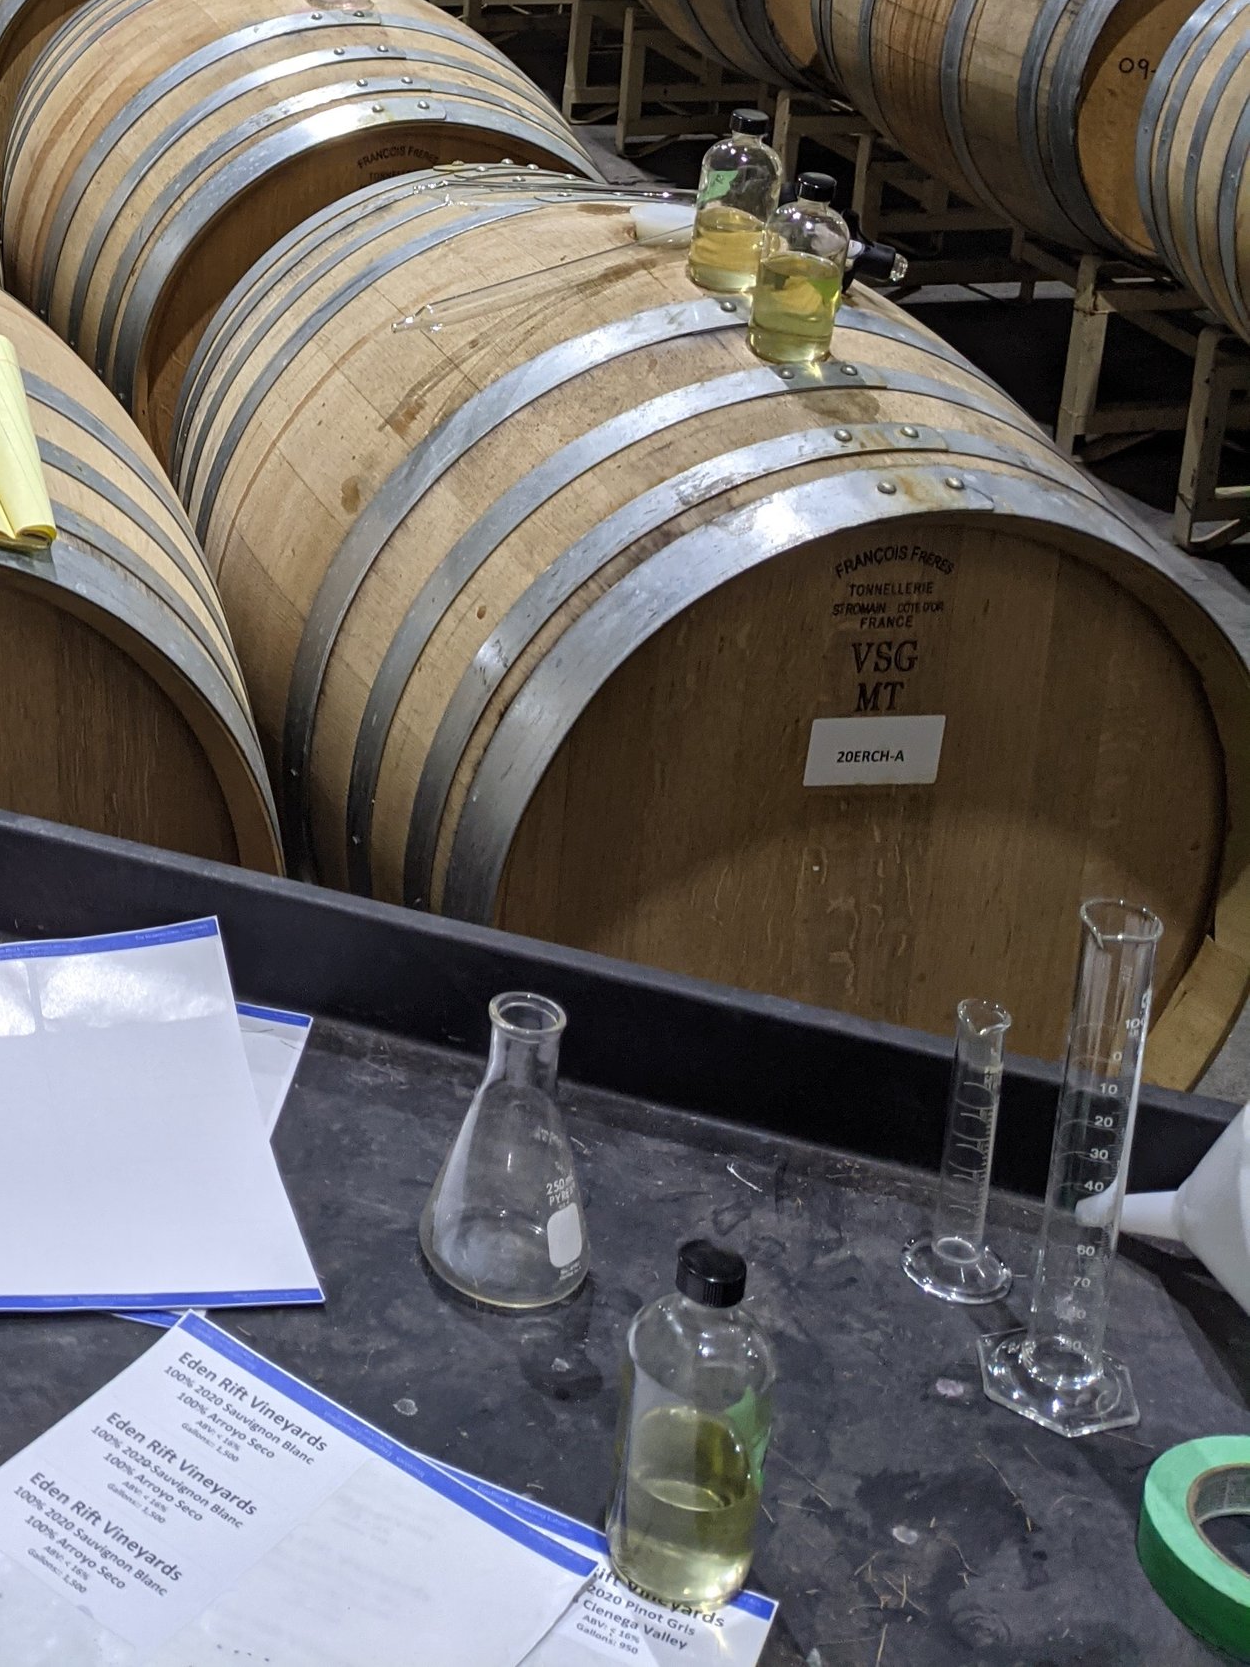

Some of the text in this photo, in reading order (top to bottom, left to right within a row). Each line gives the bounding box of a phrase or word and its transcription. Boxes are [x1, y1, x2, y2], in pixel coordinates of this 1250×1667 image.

[850, 581, 934, 597] TONNELLERIE
[860, 615, 914, 629] FRANCE
[851, 640, 919, 674] VSG
[854, 681, 905, 713] MT
[836, 749, 905, 763] 20ERCH-A
[1100, 1083, 1118, 1094] 10
[1094, 1115, 1113, 1128] 20
[1090, 1148, 1109, 1160] 30
[1084, 1180, 1104, 1192] 40
[1077, 1244, 1095, 1256] 60
[1073, 1276, 1091, 1288] 70
[164, 1366, 315, 1465] 100% 2020 Sauvignon Blanc
[179, 1352, 216, 1381] Eden
[218, 1378, 248, 1401] Rift
[250, 1396, 328, 1451] Vineyards
[177, 1393, 275, 1459] 100% Arroyo Seco
[91, 1426, 244, 1528] 100% 2020 Sauvignon Blanc
[106, 1412, 257, 1515] Eden Rift Vineyards
[103, 1453, 203, 1521] 100% Arroyo Seco
[14, 1486, 168, 1596] 100% 2020 Sauvignon Blanc
[30, 1472, 182, 1581] Eden Rift Vineyards
[25, 1515, 126, 1589] 100% Arroyo Seco
[583, 1600, 688, 1650] Cienega Valley
[587, 1586, 695, 1636] 2020 Pinot Gris
[577, 1623, 638, 1654] Gallons: 950
[583, 1615, 607, 1630] ABV:
[619, 1630, 640, 1644] 16%
